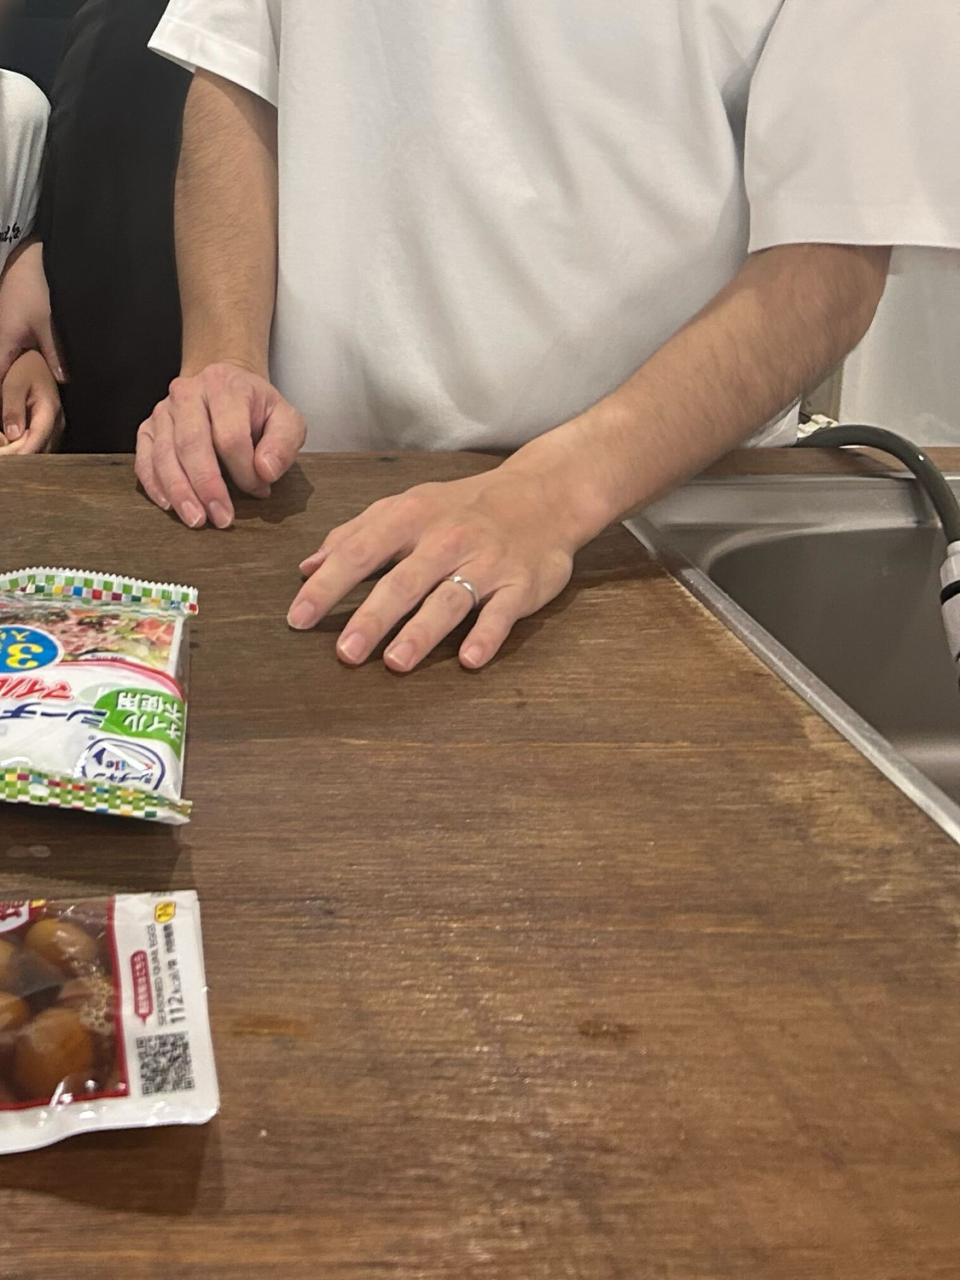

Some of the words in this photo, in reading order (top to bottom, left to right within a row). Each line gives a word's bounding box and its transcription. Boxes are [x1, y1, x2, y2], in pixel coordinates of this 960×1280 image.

[116, 691, 184, 721] 不使用
[123, 710, 183, 742] オイル
[146, 923, 158, 946] EGGS
[150, 947, 162, 976] QUAIL
[154, 977, 168, 1026] SEASONED
